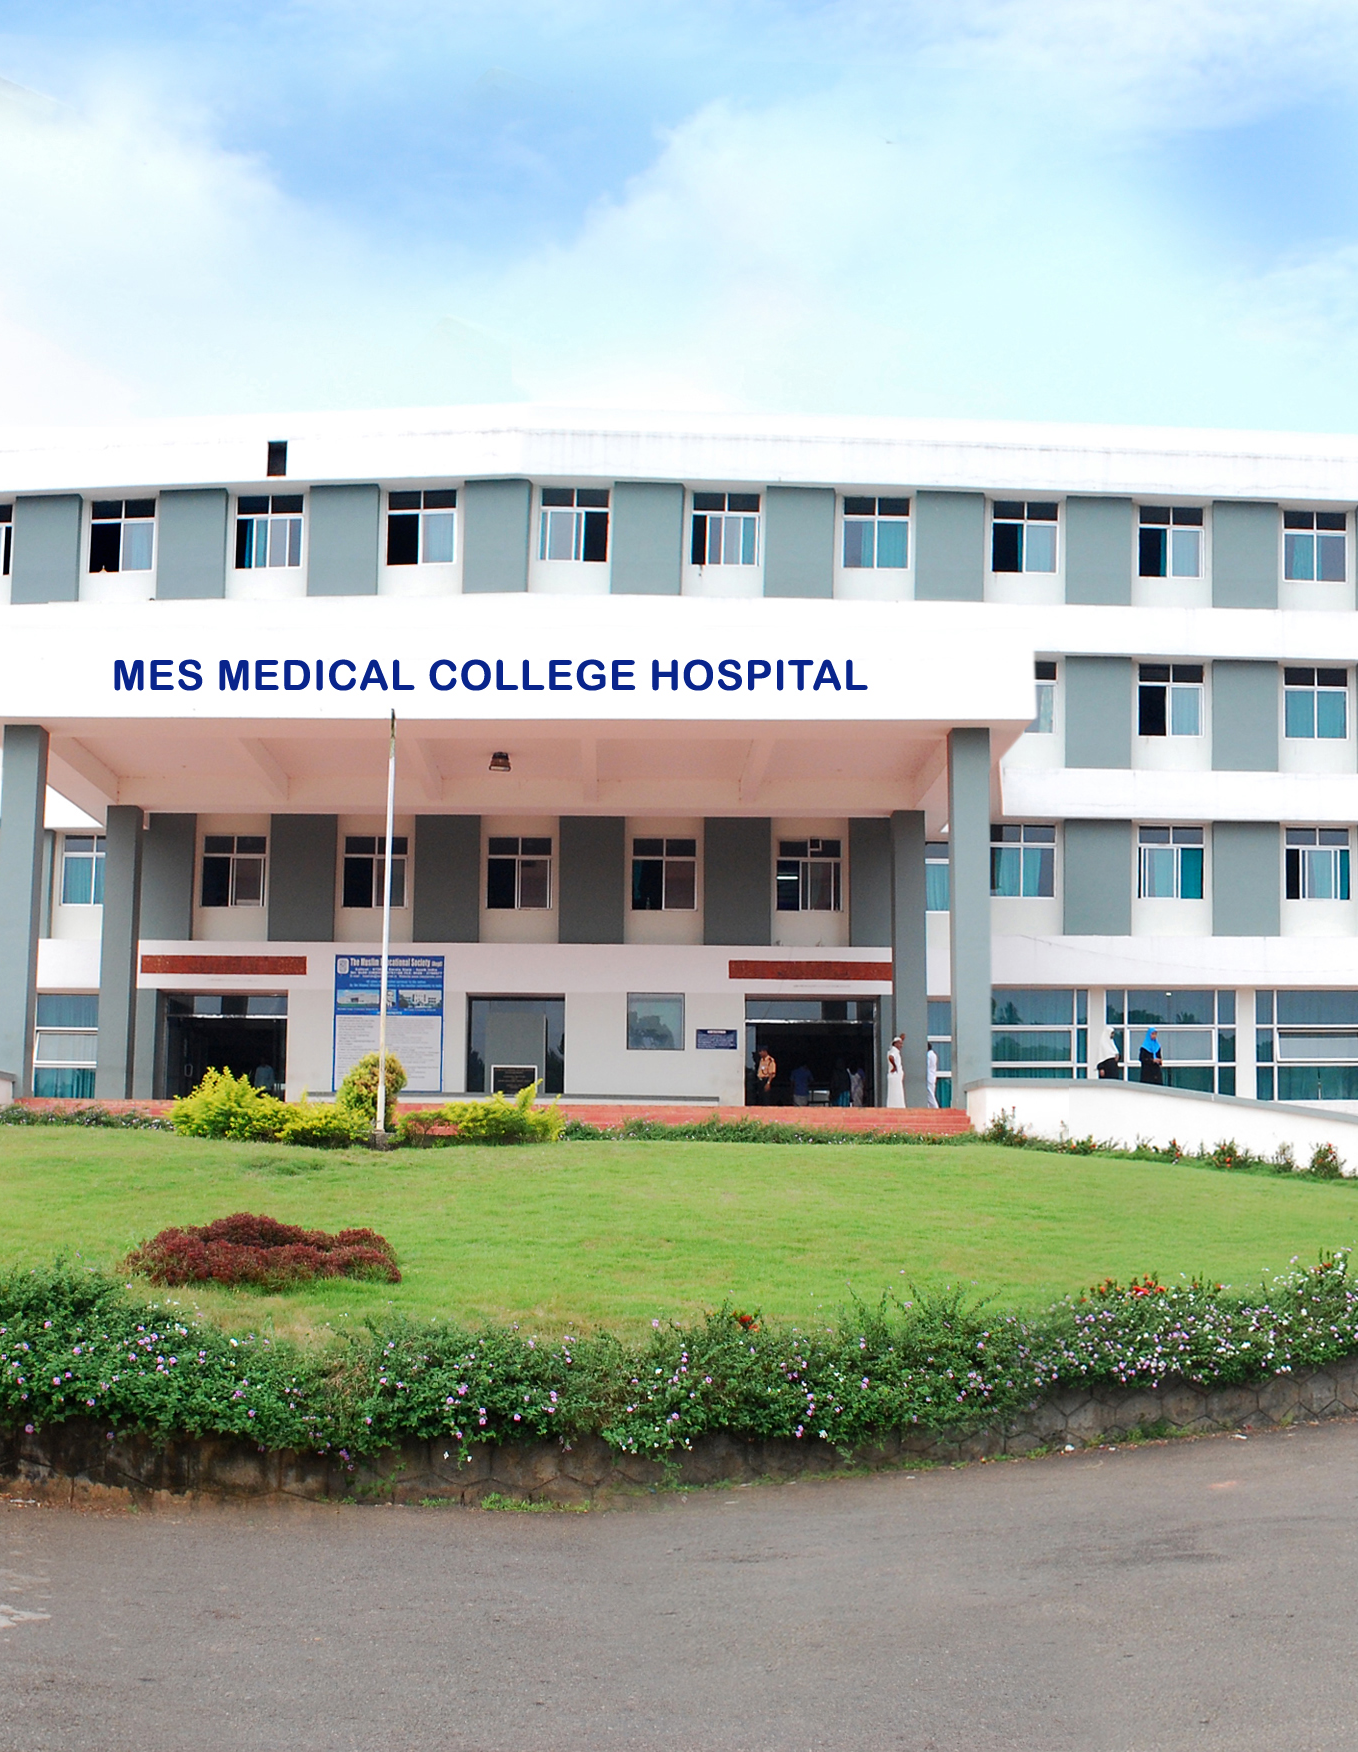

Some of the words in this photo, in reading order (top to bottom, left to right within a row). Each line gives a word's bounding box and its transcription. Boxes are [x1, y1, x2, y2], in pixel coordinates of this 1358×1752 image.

[113, 658, 203, 692] MES
[218, 658, 416, 692] MEDICAL
[428, 658, 636, 692] COLLEGE
[651, 658, 869, 692] HOSPITAL
[350, 957, 360, 967] The
[380, 957, 411, 967] Ecational
[411, 957, 431, 968] Society
